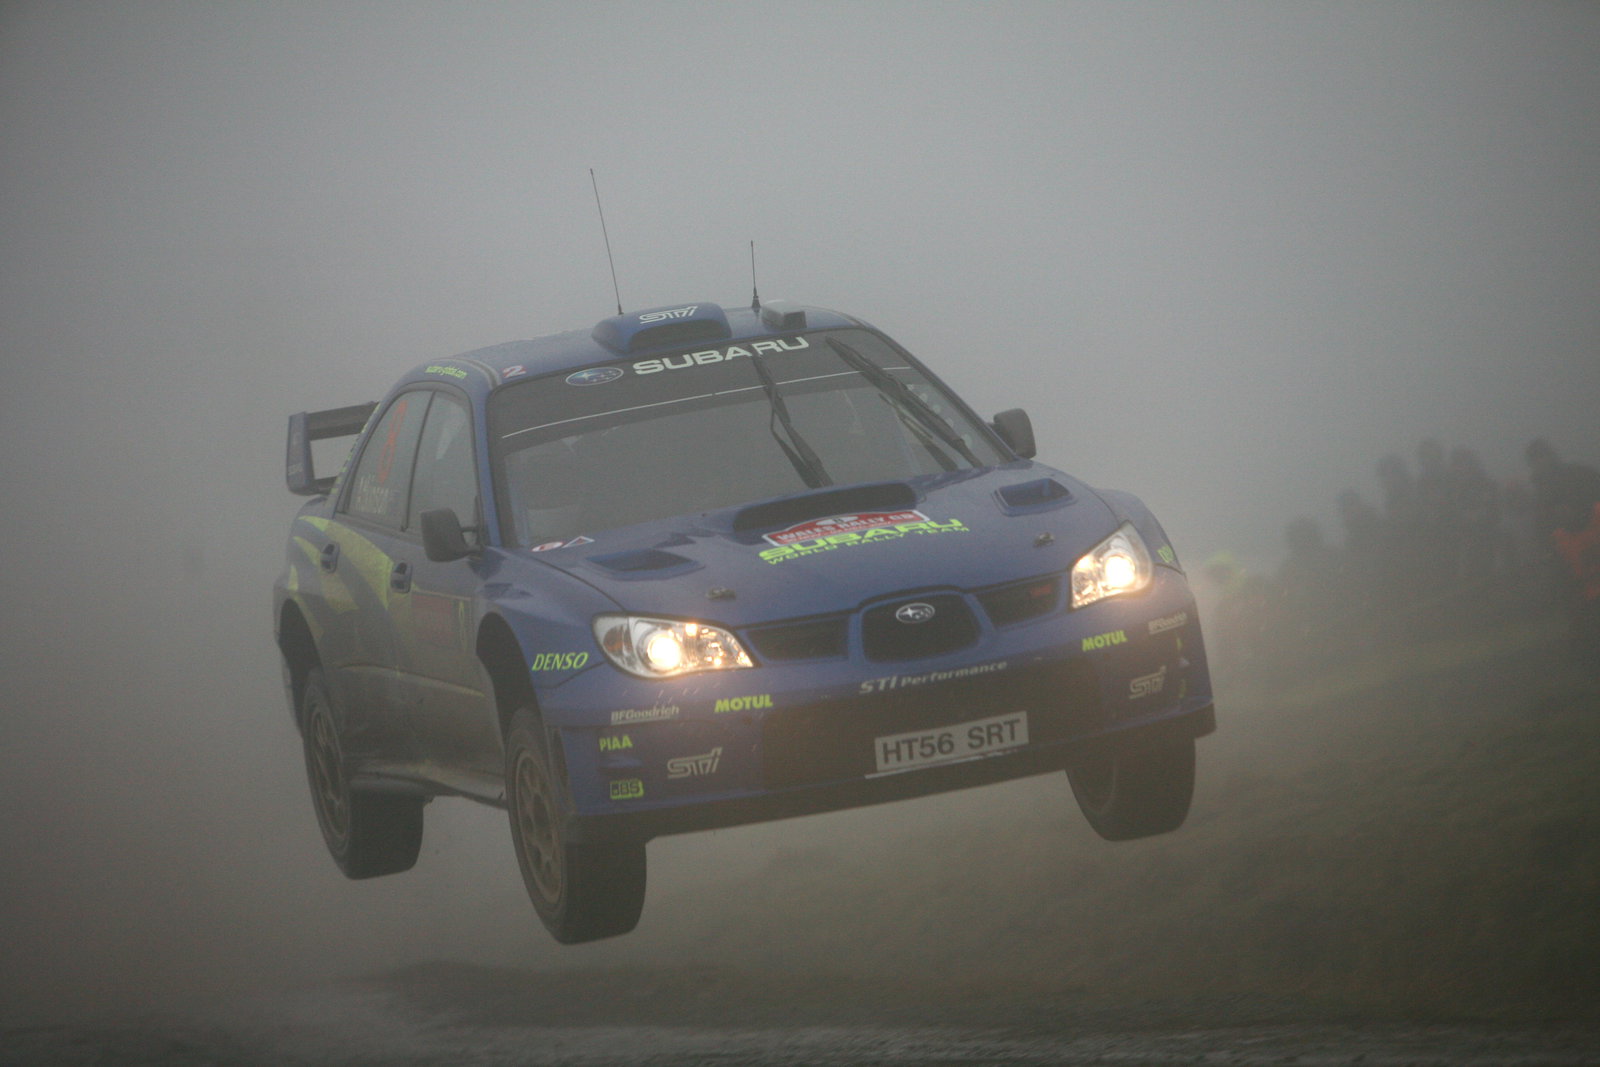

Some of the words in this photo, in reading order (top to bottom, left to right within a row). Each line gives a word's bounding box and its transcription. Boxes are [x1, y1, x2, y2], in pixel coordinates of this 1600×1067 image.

[633, 336, 809, 375] SUBARU
[838, 516, 885, 530] RALLY
[758, 518, 964, 561] SUBARU
[767, 547, 836, 565] WORLD
[846, 533, 904, 548] RALLY
[917, 526, 970, 536] TEAM
[1082, 630, 1128, 651] MOTUL
[531, 652, 589, 671] DENSO
[900, 661, 1007, 687] Performance
[610, 704, 680, 724] BFGoodrich
[715, 694, 773, 713] MOTUL
[599, 735, 633, 751] PIAA
[882, 733, 954, 764] HT56
[967, 718, 1020, 749] SRT
